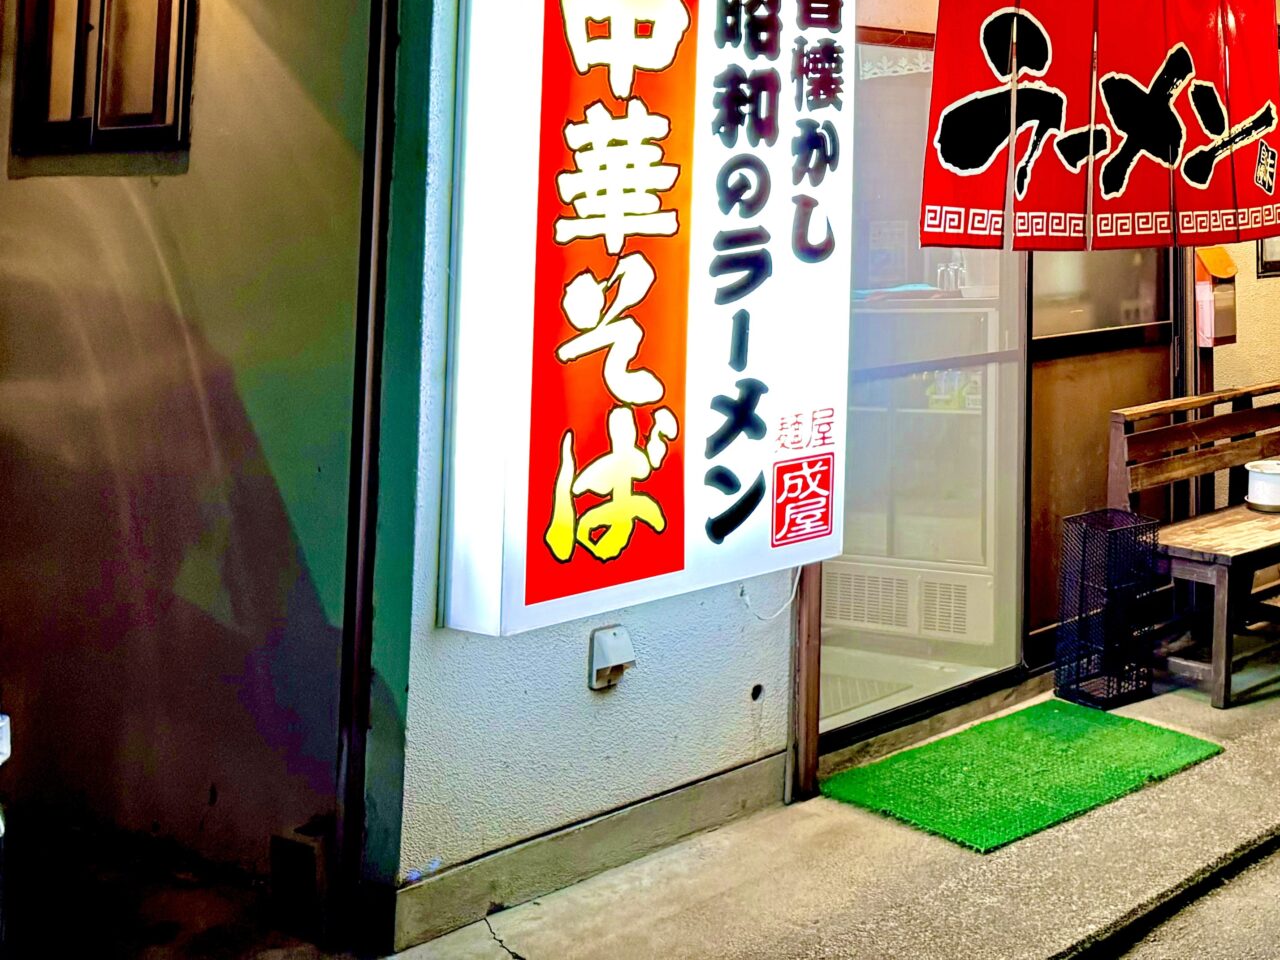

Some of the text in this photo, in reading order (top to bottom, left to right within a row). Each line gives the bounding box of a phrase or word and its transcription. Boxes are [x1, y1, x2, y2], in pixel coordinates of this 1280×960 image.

[934, 6, 1277, 200] ラーメン
[775, 460, 830, 540] 成屋
